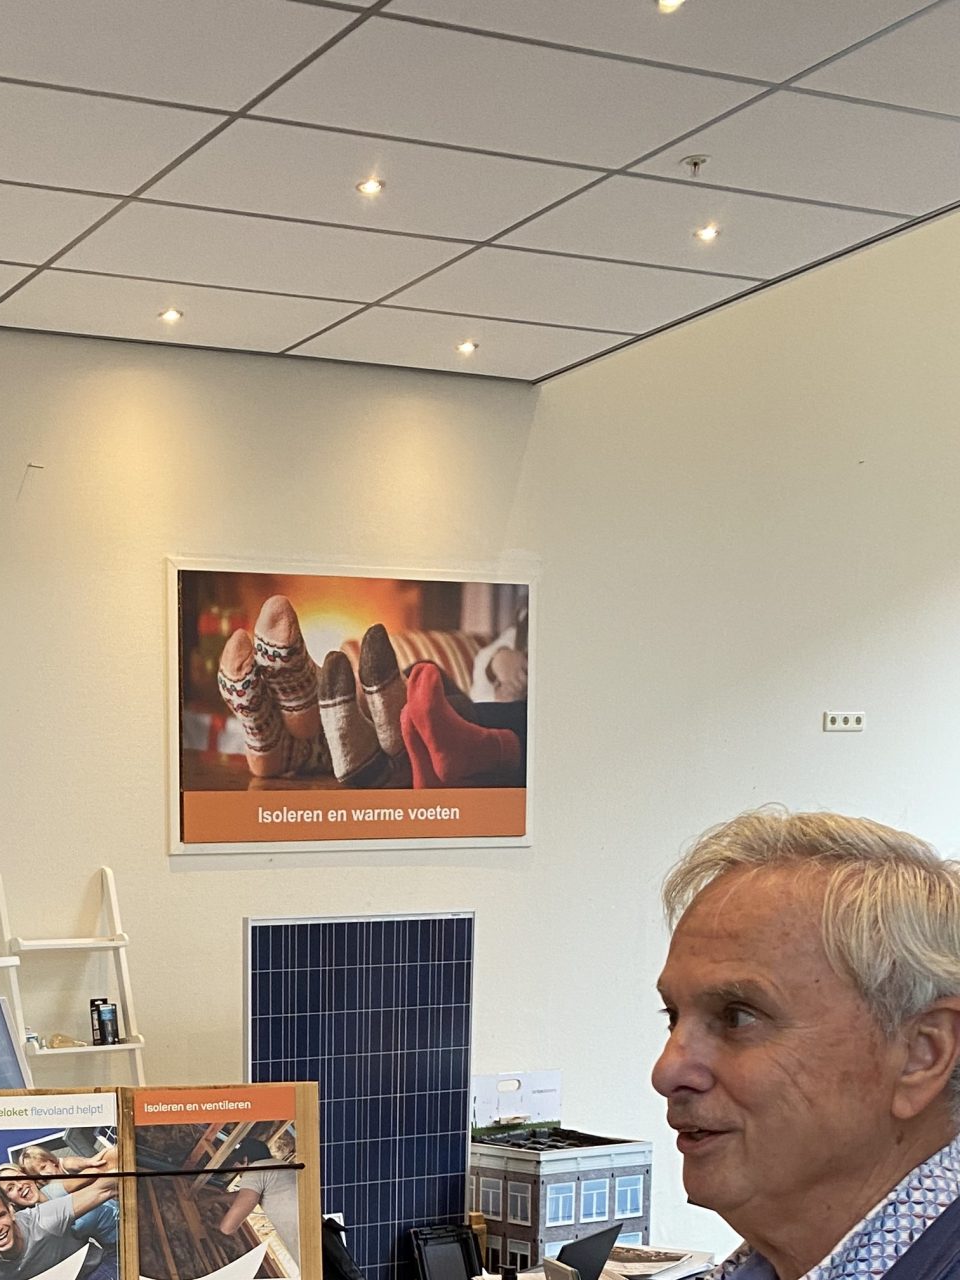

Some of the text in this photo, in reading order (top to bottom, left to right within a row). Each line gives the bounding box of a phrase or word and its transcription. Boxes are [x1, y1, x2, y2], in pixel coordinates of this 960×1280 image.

[257, 806, 460, 823] Isoleren en warme voeten
[30, 1105, 75, 1117] flevoland
[76, 1104, 103, 1116] helpt!
[144, 1099, 252, 1113] Isoleren en ventileren
